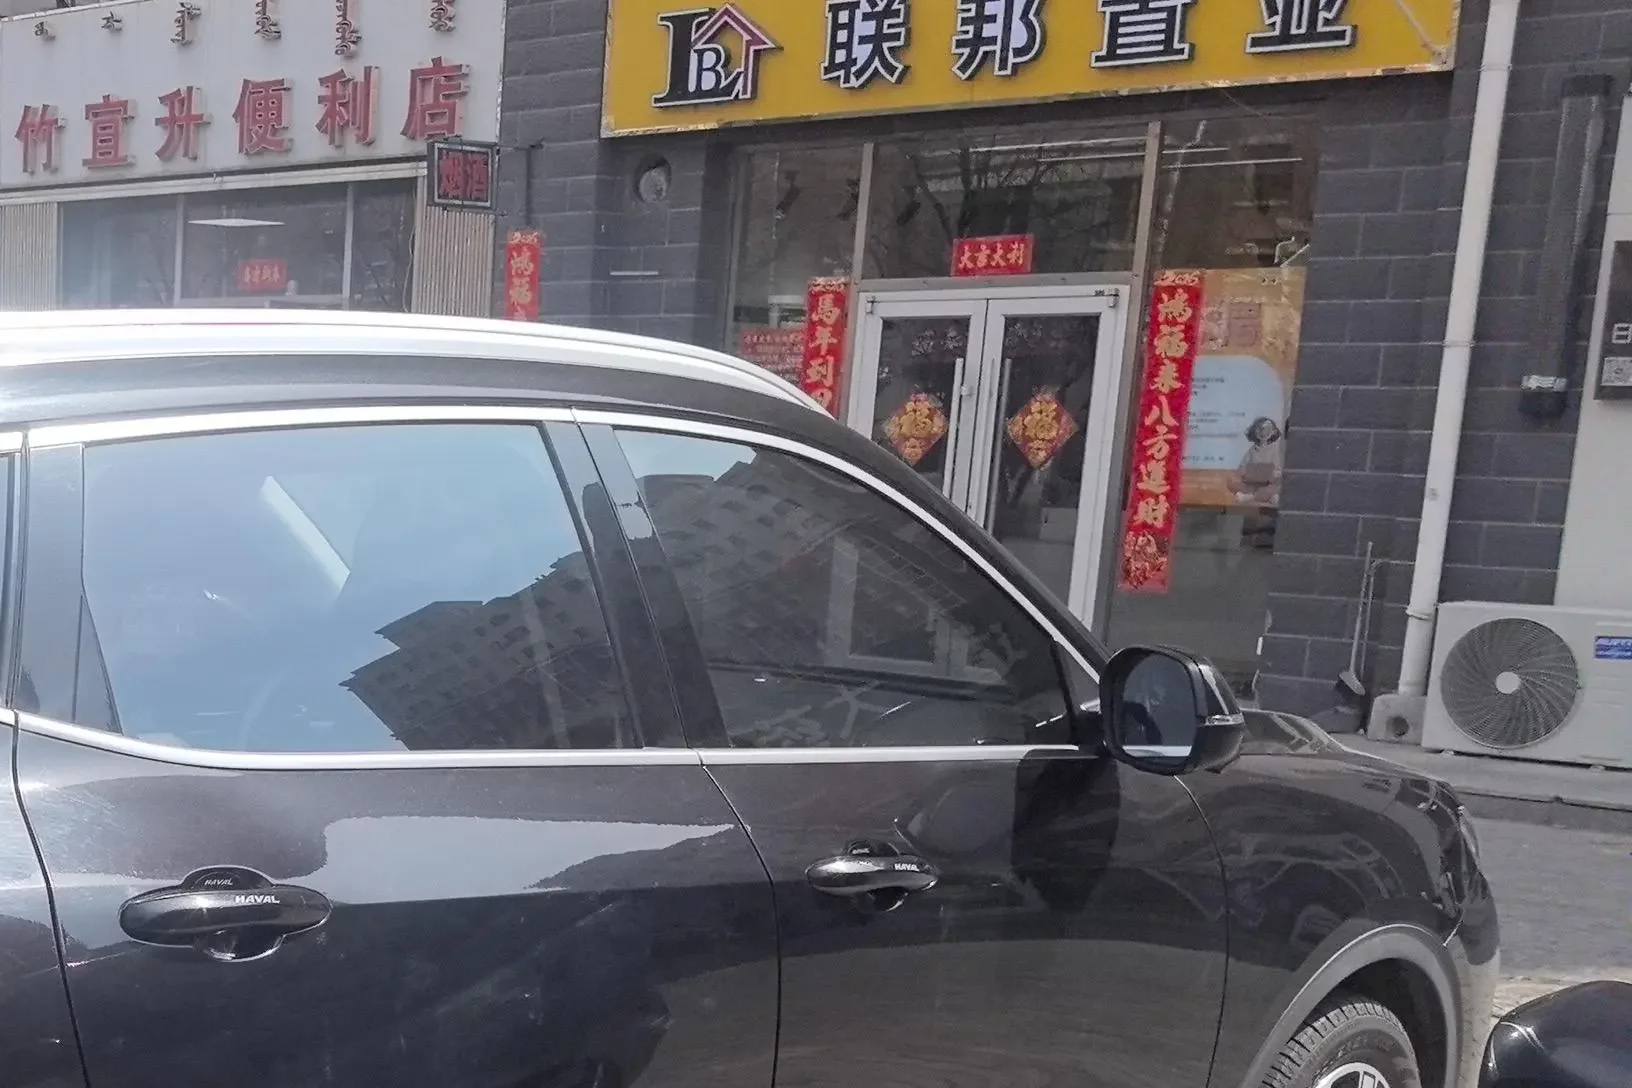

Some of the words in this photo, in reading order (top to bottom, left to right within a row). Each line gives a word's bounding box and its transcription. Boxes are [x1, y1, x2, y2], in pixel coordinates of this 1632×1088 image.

[14, 56, 470, 174] 竹宜升便利店
[958, 243, 1026, 269] 大吉大利
[204, 877, 233, 886] HAVAL
[235, 895, 280, 904] HAVAL
